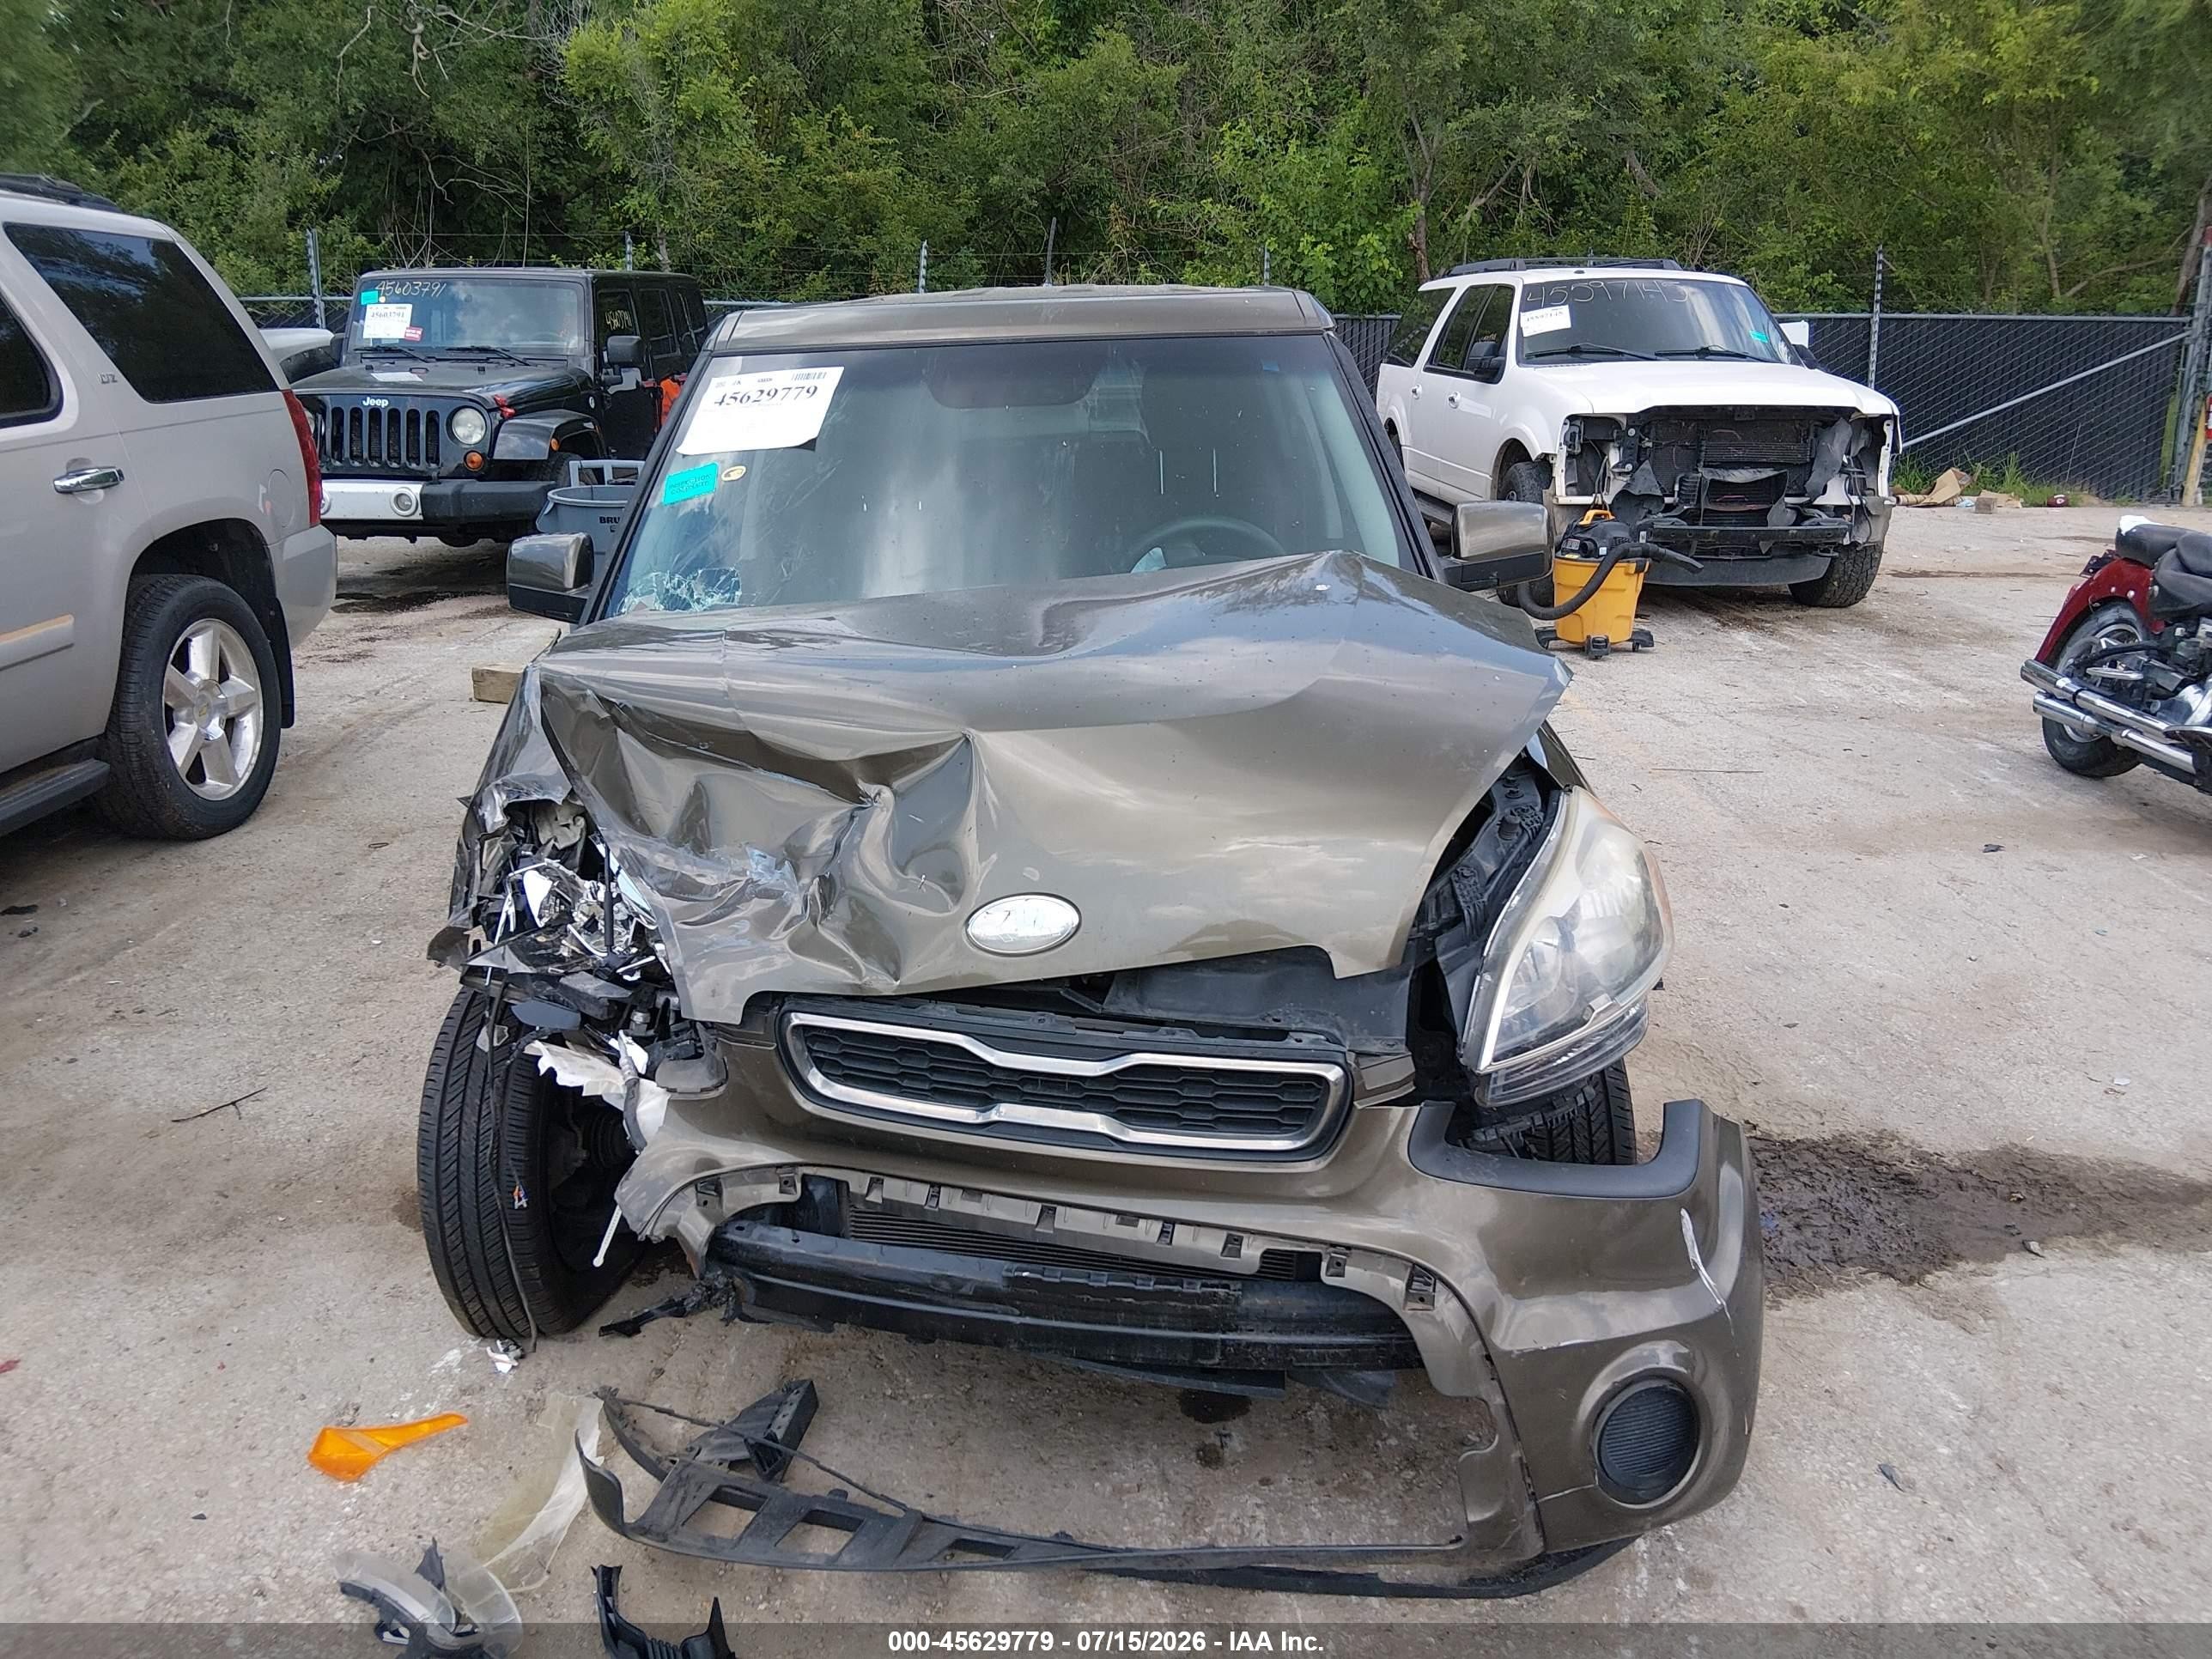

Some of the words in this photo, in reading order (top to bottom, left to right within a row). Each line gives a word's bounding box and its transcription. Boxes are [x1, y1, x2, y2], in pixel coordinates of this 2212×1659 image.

[375, 280, 447, 298] 45603791
[1527, 280, 1689, 307] 45597145
[362, 397, 389, 408] Jeep
[714, 385, 819, 407] 45629779
